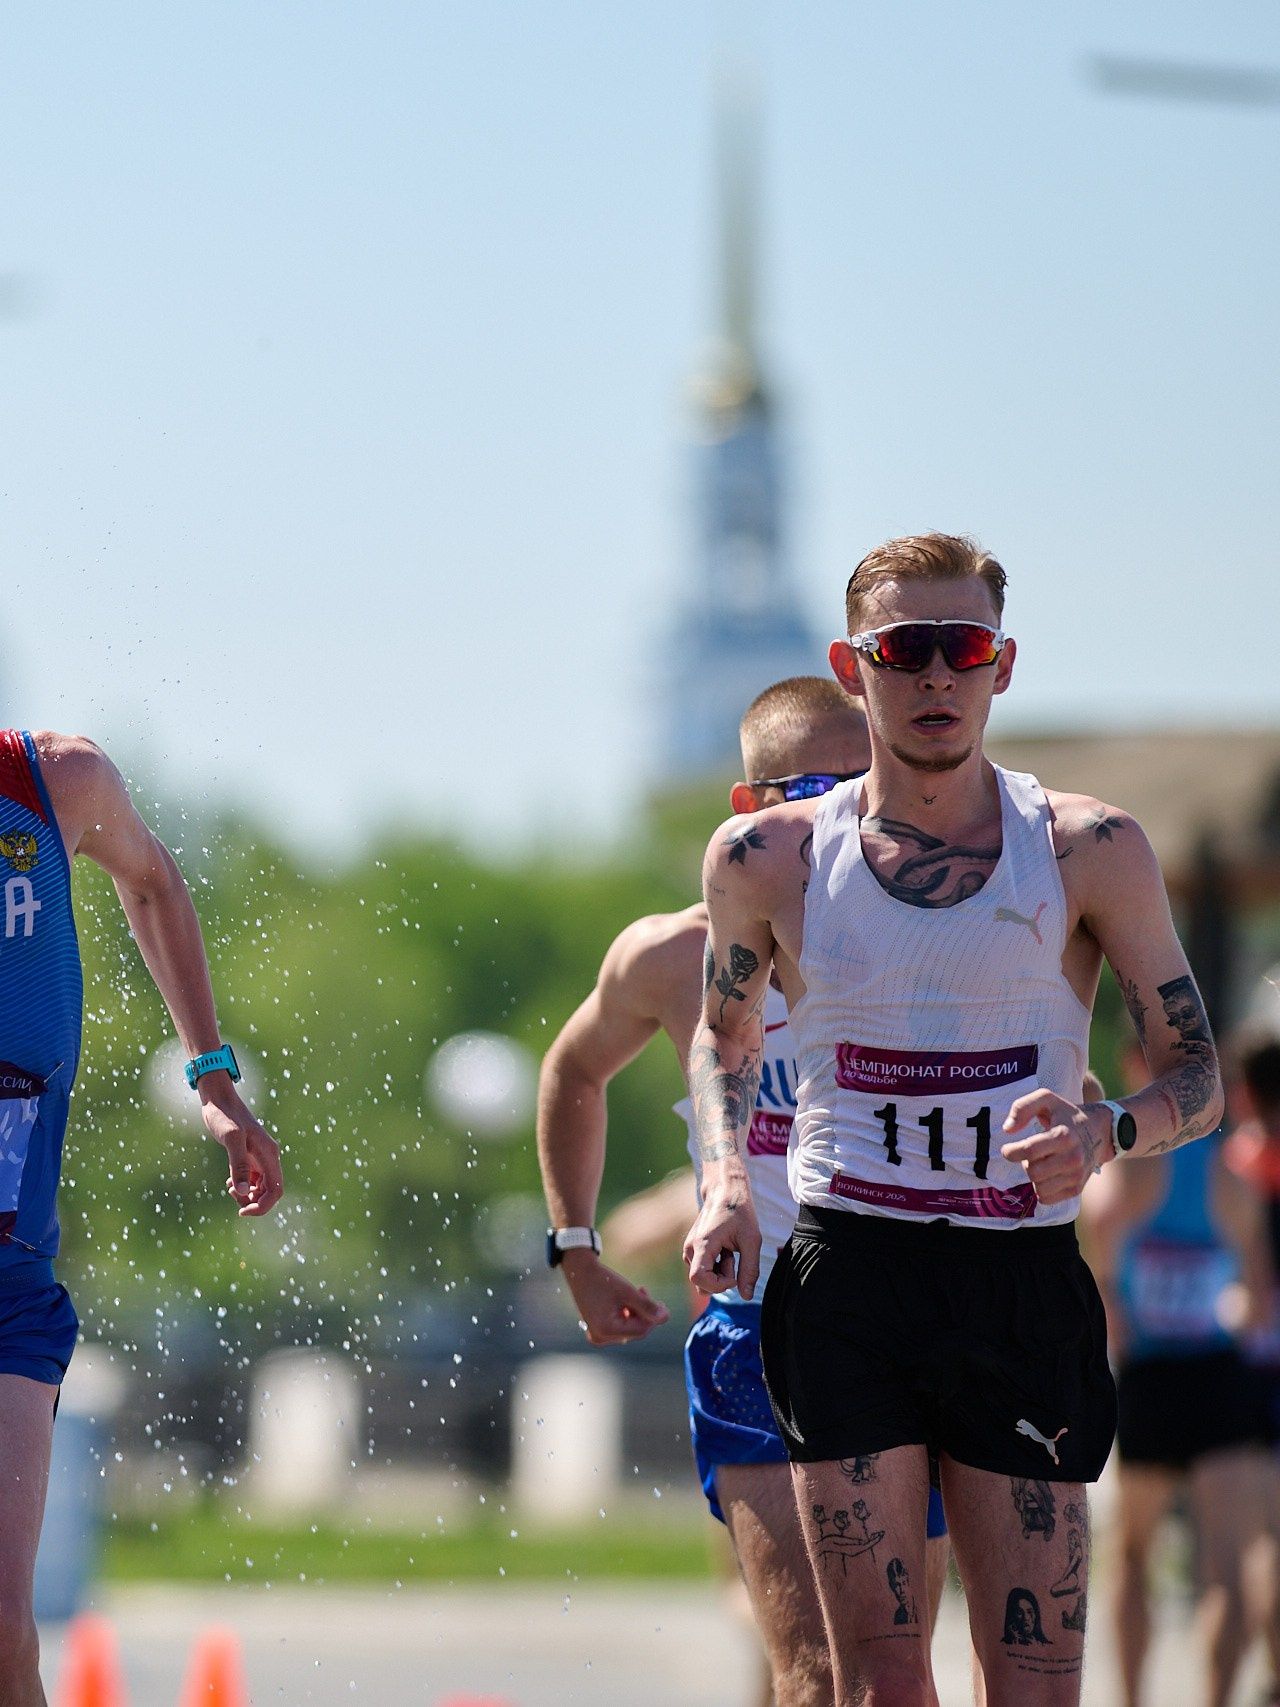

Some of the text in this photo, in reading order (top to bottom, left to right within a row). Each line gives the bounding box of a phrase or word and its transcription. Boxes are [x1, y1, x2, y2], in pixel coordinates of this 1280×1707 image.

[842, 1069, 898, 1085] по ходьбе
[844, 1058, 1018, 1078] ЧЕМПИОНАТ РОССИИ
[874, 1103, 991, 1180] 111
[837, 1181, 907, 1202] ВОТКИНСК 2025
